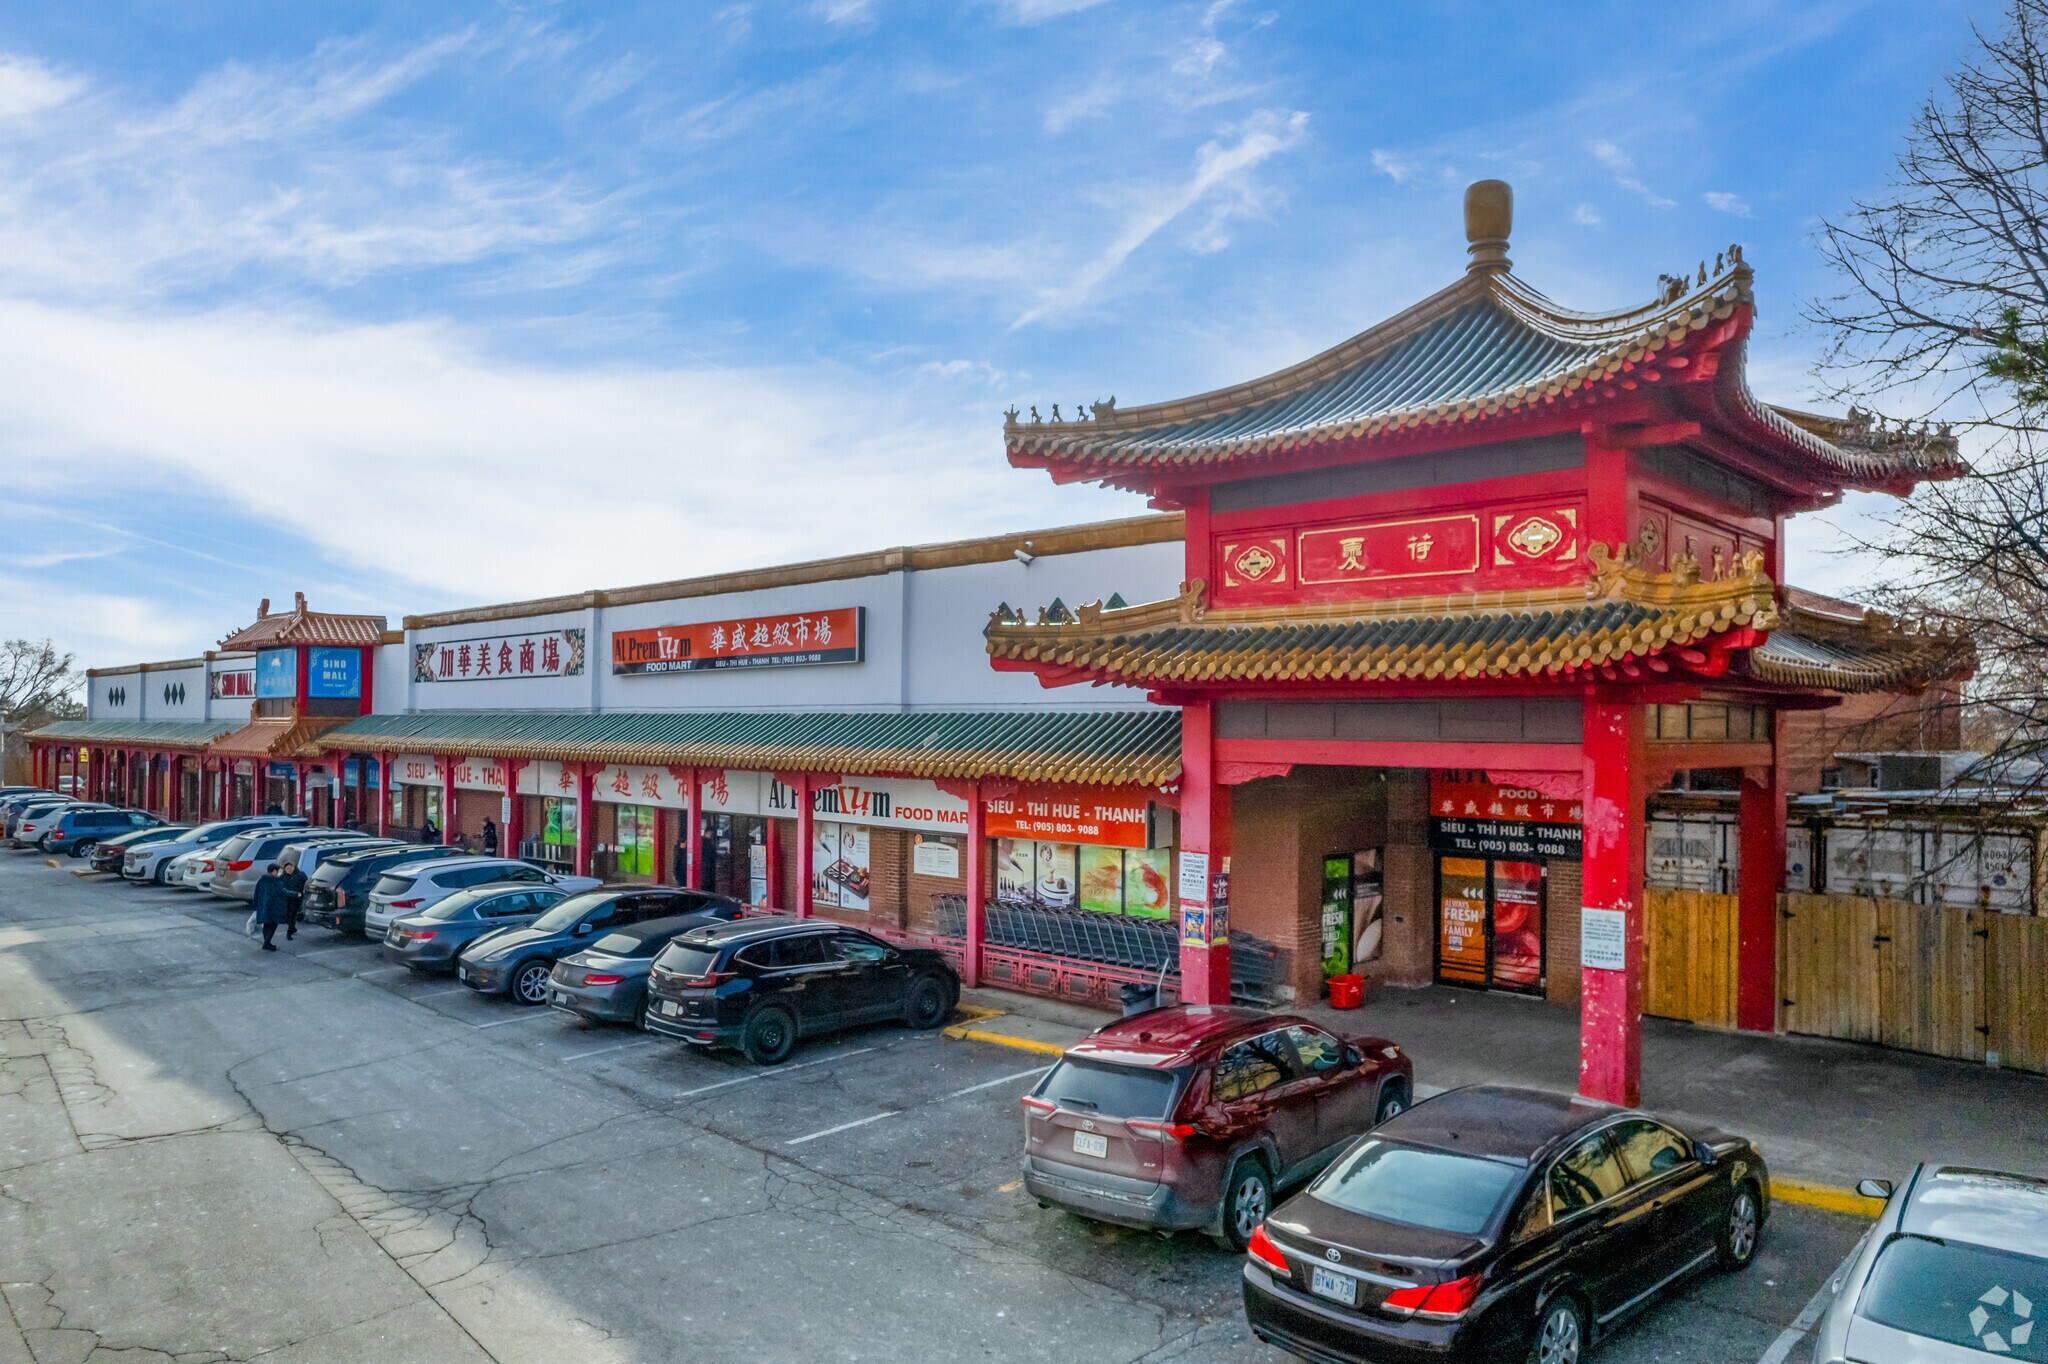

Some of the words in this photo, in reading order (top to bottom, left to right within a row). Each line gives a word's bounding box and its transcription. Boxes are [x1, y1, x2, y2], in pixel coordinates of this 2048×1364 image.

[709, 616, 833, 655] 華盛超級市場
[628, 630, 692, 660] Premium
[323, 659, 346, 669] SINO
[782, 656, 795, 664] (905)
[808, 653, 821, 662] 9088
[646, 661, 667, 672] FOOD
[668, 661, 692, 671] MART
[323, 671, 346, 680] MALL
[1498, 788, 1538, 799] FOOD
[895, 806, 933, 822] FOOD
[937, 809, 969, 824] MAR
[1015, 820, 1032, 830] TEL:
[1033, 822, 1054, 834] (905)
[1056, 824, 1075, 833] 803-
[1077, 825, 1099, 835] 9088
[1455, 838, 1476, 849] TEL:
[1479, 840, 1506, 853] (905)
[1509, 841, 1534, 853] 803-
[1537, 843, 1565, 855] 9088
[1444, 900, 1469, 909] ALWAYS
[1322, 911, 1344, 927] FRESH
[1444, 907, 1478, 922] FRESH
[1444, 925, 1473, 937] FAMILY
